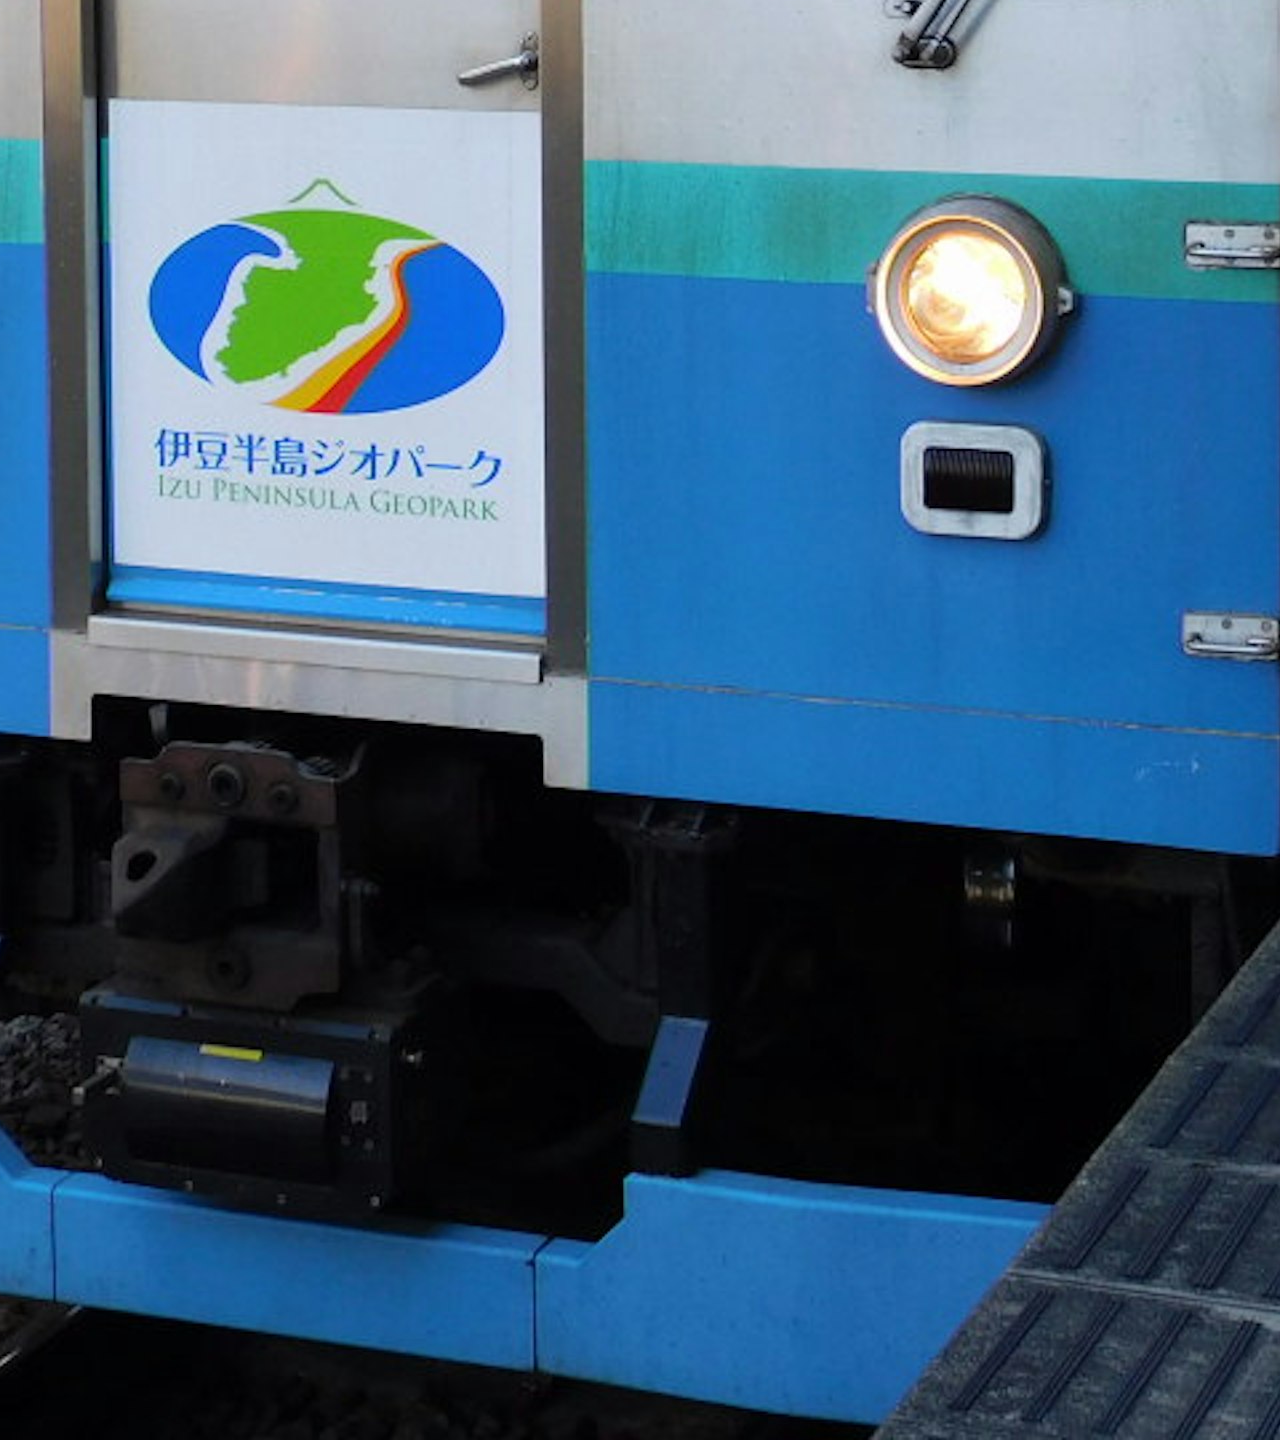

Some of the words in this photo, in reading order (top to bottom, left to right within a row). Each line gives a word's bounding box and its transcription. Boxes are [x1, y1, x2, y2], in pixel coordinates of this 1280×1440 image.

[155, 429, 501, 487] 伊豆半島ジオパーク
[159, 474, 201, 499] IZU
[214, 478, 360, 513] PENINSULA
[370, 489, 499, 521] GEOPARK
